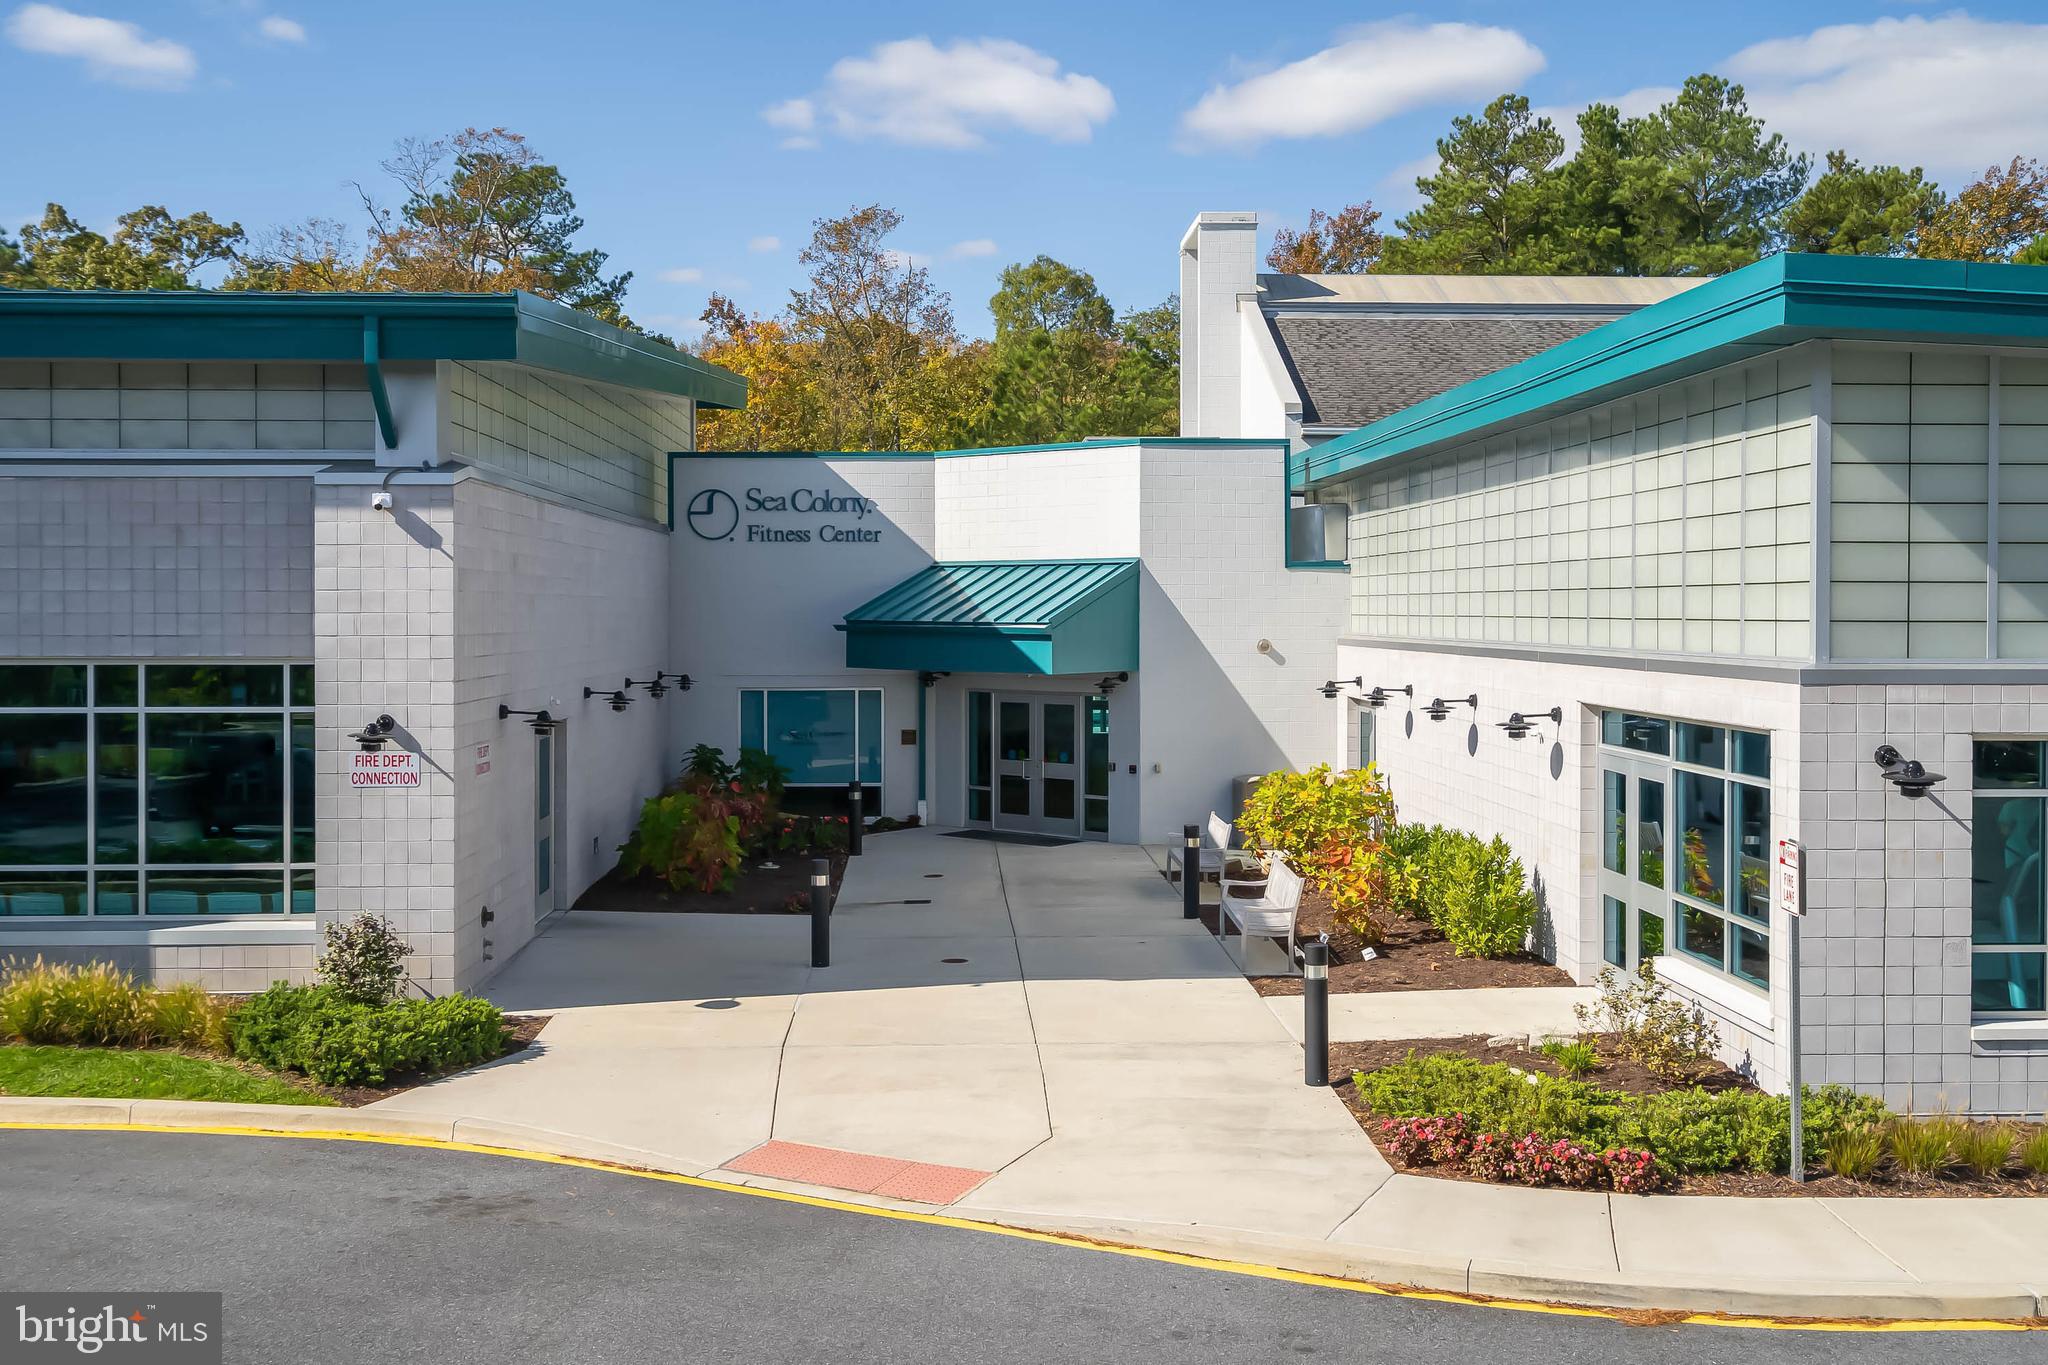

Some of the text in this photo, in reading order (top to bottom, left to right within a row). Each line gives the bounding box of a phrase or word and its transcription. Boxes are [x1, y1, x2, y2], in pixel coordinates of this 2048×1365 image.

[746, 487, 786, 512] Sea
[747, 524, 881, 543] Fitness Center
[355, 755, 414, 768] FIRE DEPT.
[351, 772, 418, 785] CONNECTION
